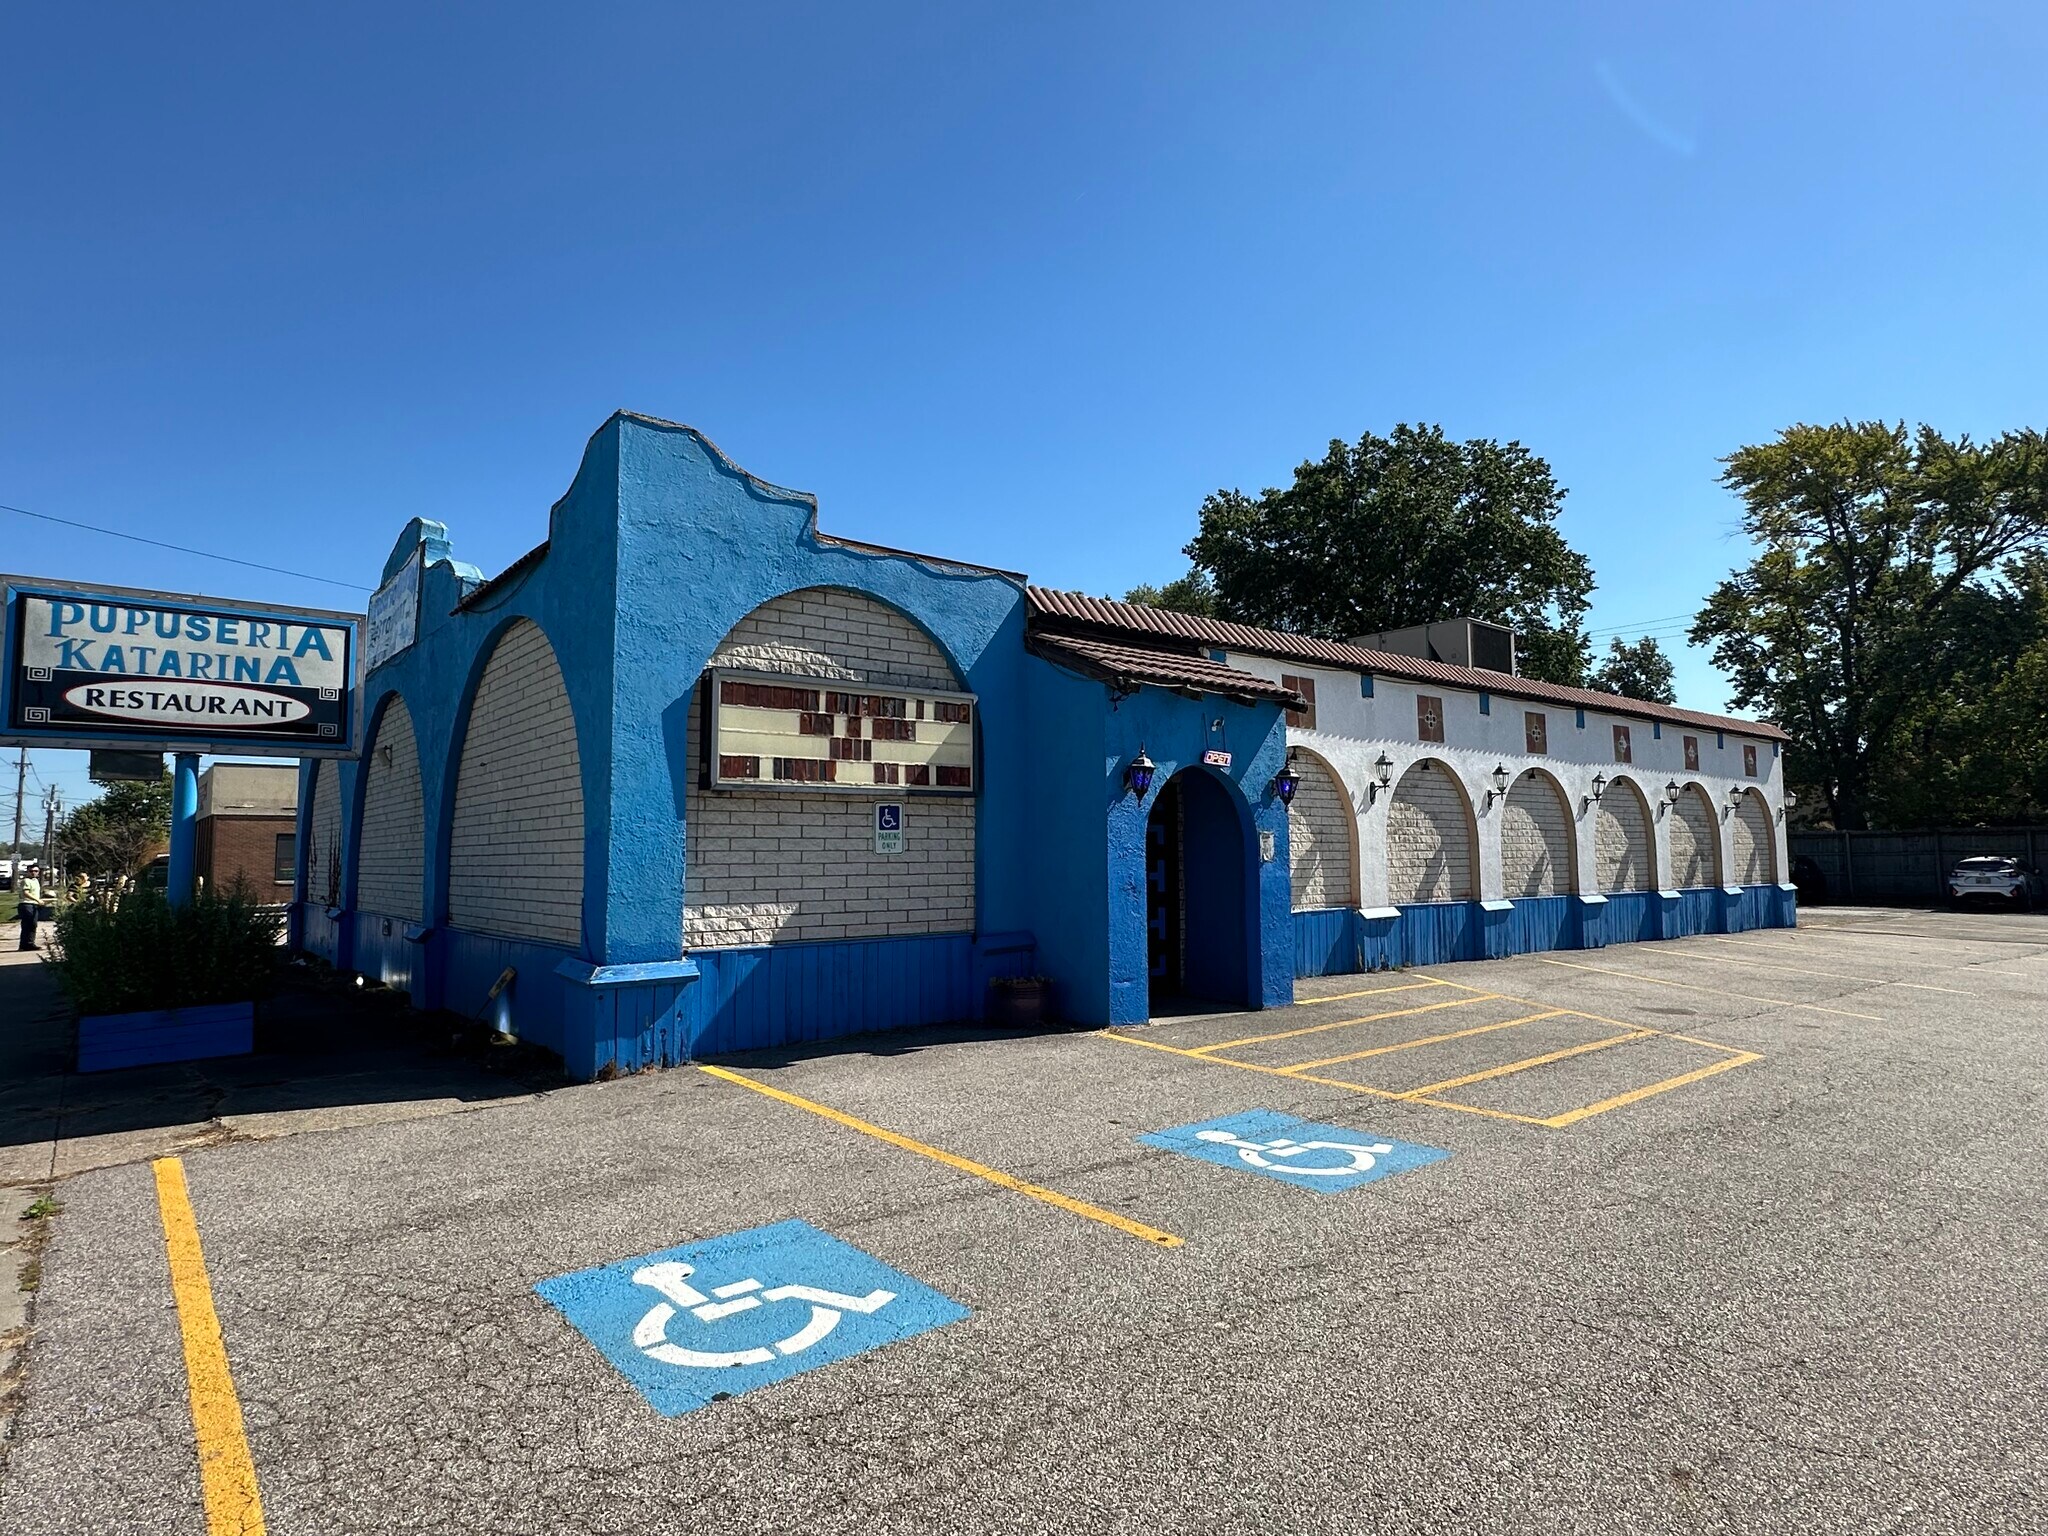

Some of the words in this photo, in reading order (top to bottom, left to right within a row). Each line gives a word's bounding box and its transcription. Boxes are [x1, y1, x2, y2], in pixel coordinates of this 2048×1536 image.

[44, 599, 333, 661] PUPUSERIA
[54, 638, 302, 686] KATARINA
[86, 688, 293, 718] RESTAURANT
[1206, 753, 1230, 764] OPEN
[878, 832, 900, 841] PARKING
[881, 842, 896, 850] ONLY
